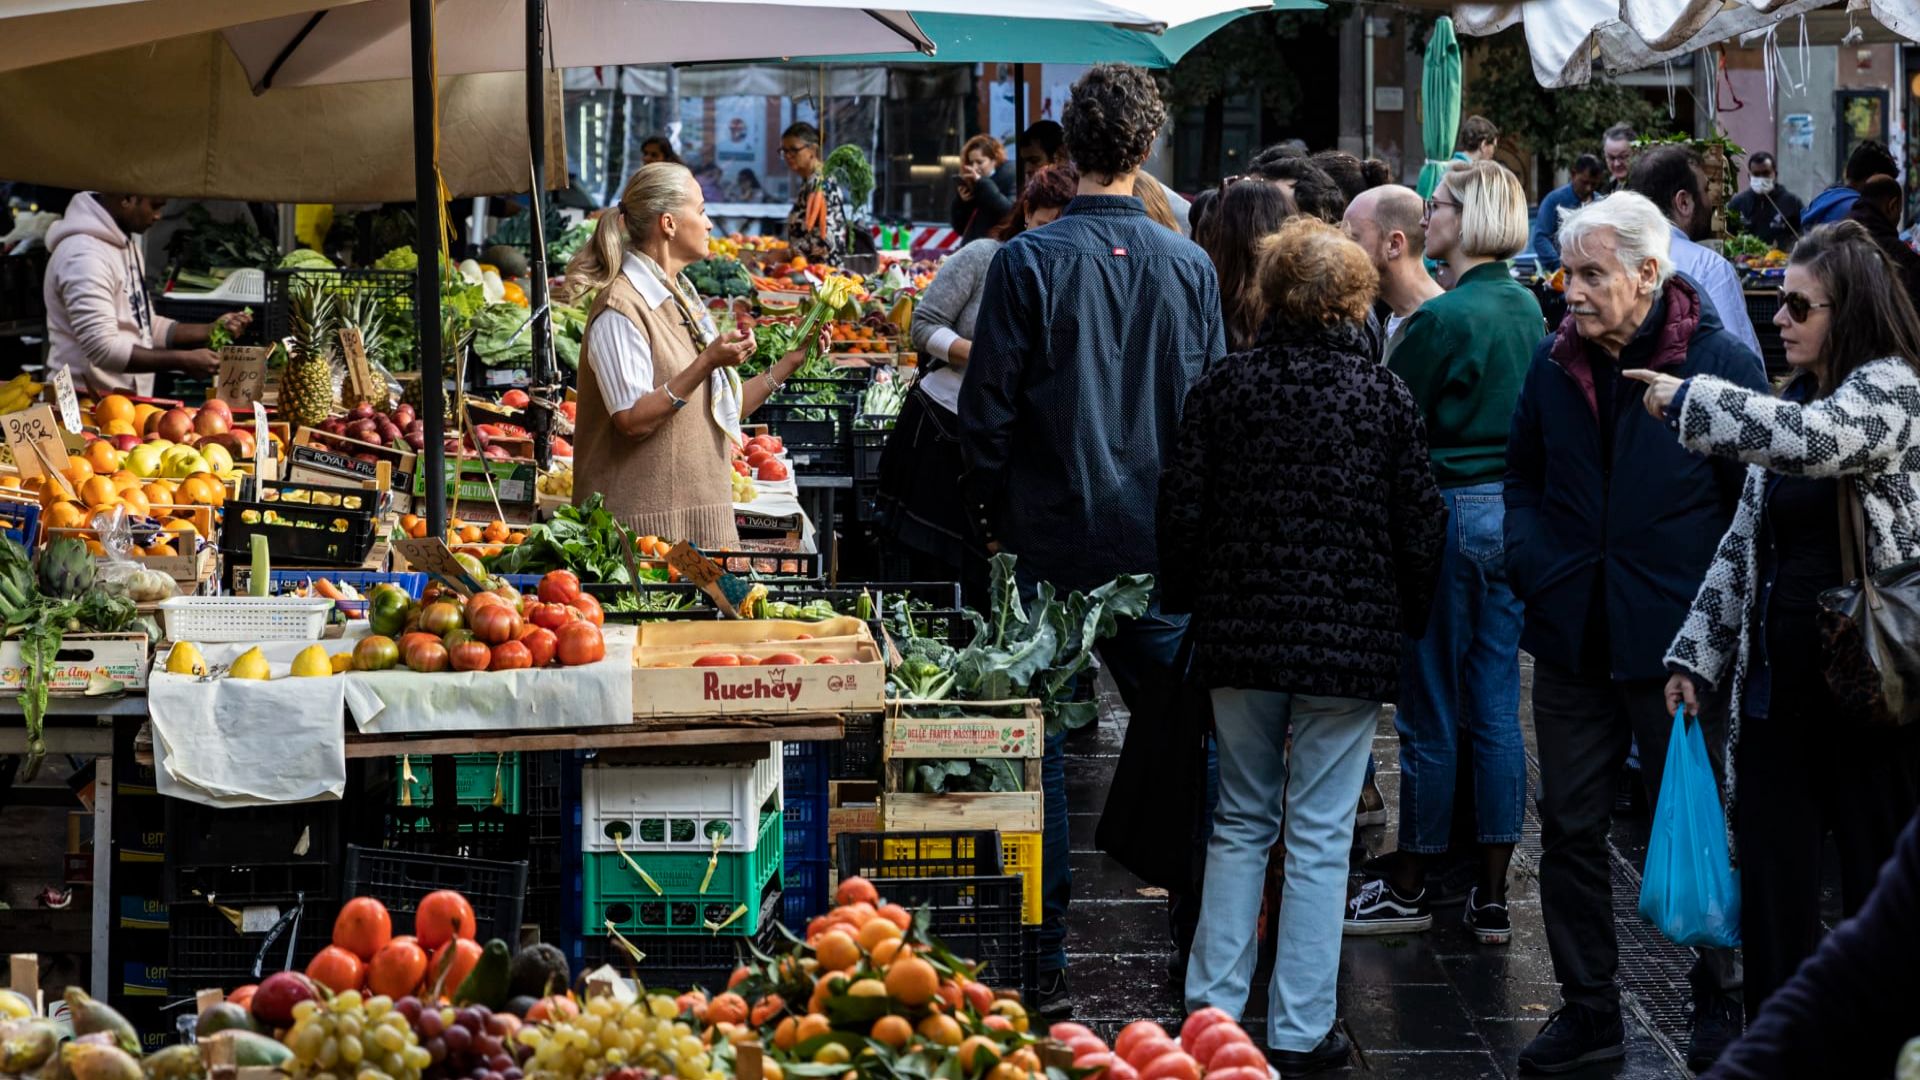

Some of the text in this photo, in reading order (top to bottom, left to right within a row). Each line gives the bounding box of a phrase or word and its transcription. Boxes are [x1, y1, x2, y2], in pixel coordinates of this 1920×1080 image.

[313, 452, 377, 475] ROYAL FRU
[747, 516, 778, 528] ROYAL
[703, 671, 802, 702] Ruchey
[907, 729, 926, 739] DELLE
